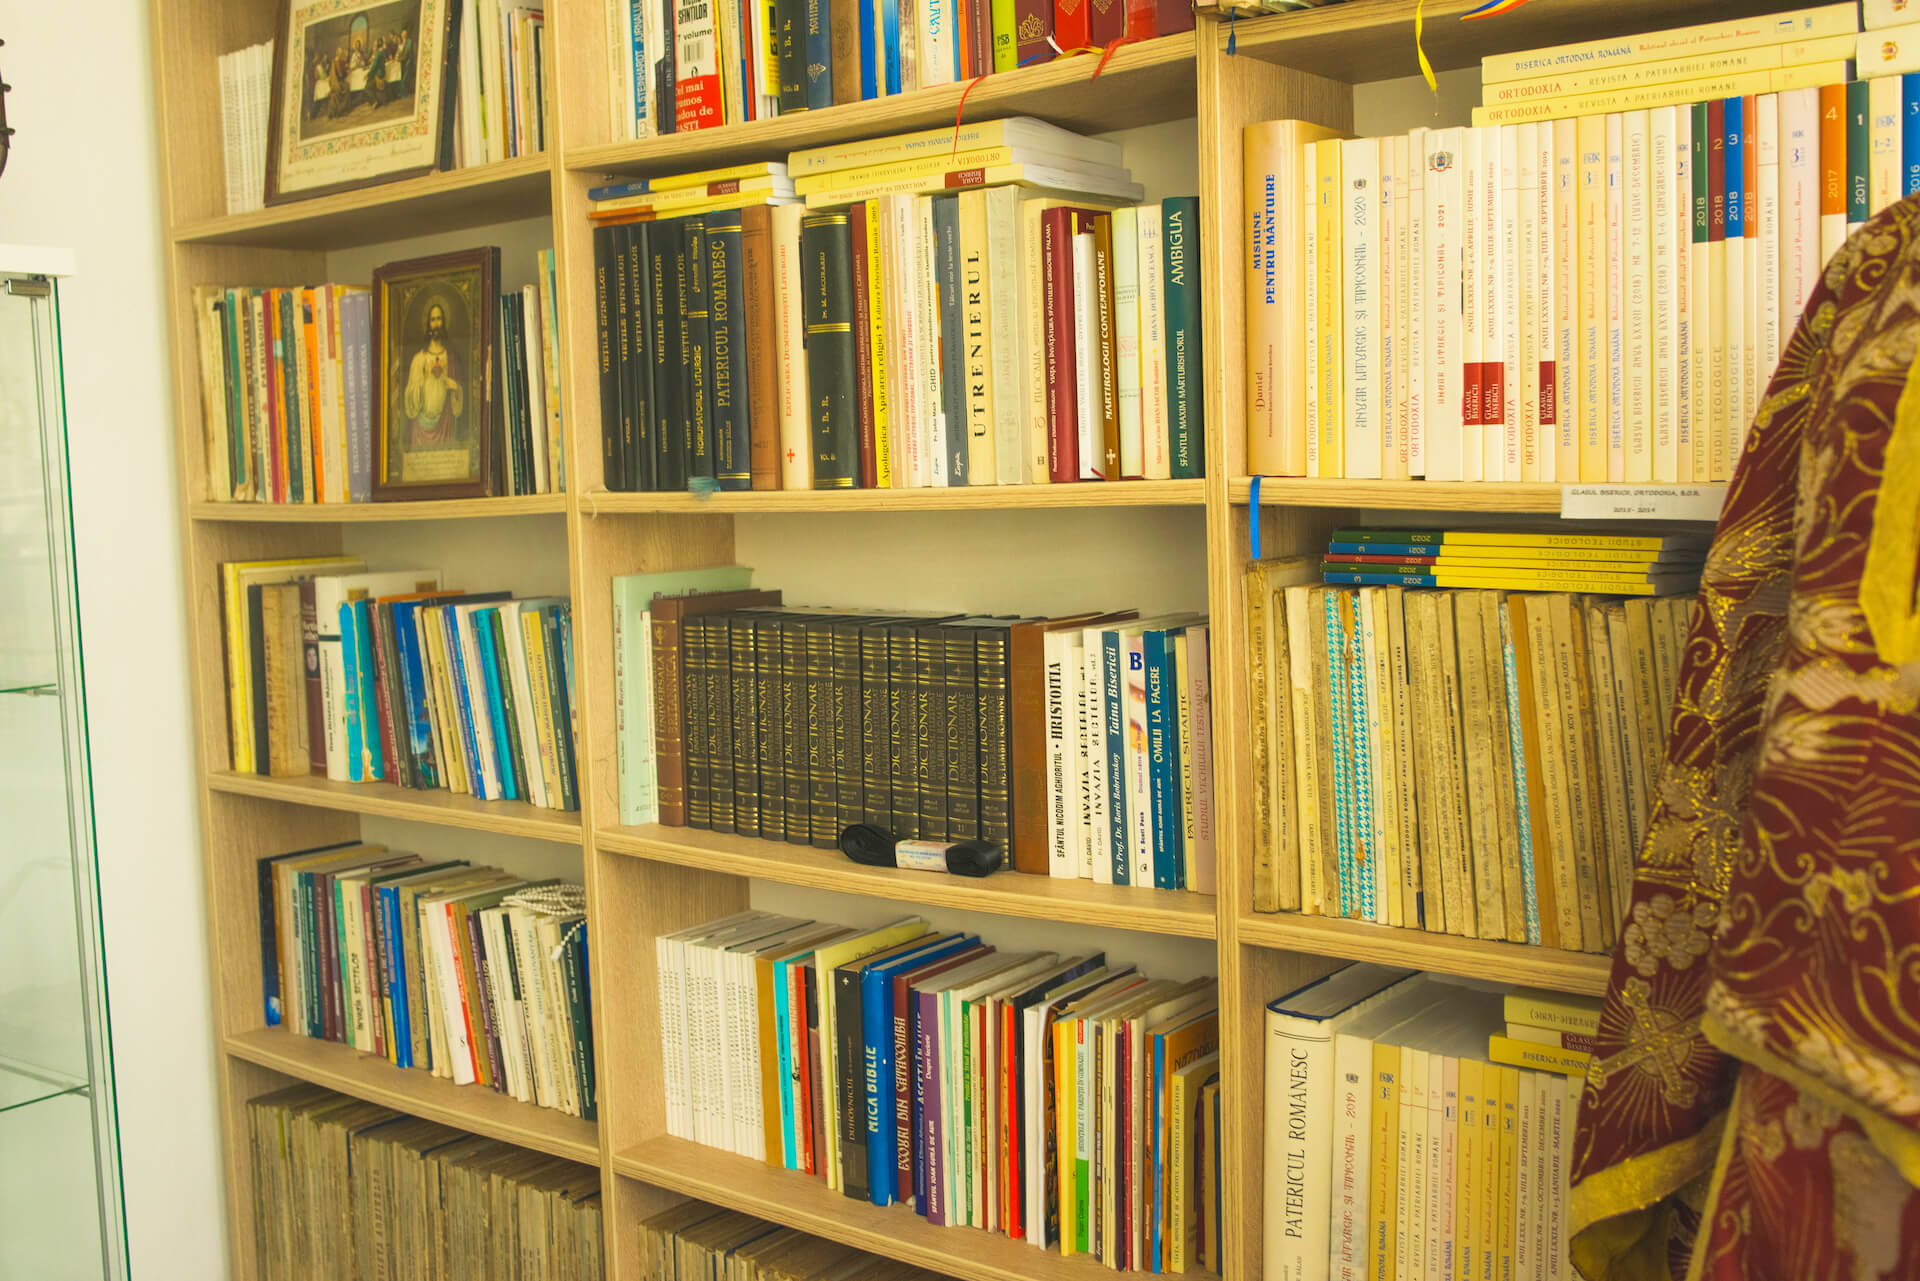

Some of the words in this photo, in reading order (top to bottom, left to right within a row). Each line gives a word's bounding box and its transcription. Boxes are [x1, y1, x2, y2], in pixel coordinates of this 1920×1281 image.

[685, 81, 704, 91] mai
[1498, 81, 1562, 100] ORTODOXIA
[699, 106, 713, 116] de
[1488, 103, 1552, 121] ORTODOXIA
[1714, 138, 1723, 150] 2
[1729, 134, 1738, 145] 3
[1828, 169, 1838, 198] 2017
[1856, 175, 1865, 204] 2017
[1264, 174, 1275, 245] MÂNTUIRE
[1354, 197, 1366, 226] 2020
[1696, 197, 1706, 226] 2018
[1713, 195, 1723, 224] 2018
[1728, 192, 1739, 221] 2018
[1744, 192, 1753, 222] 2018
[1169, 211, 1184, 285] AMBIGUA
[1253, 211, 1261, 270] MISIUNE
[1266, 249, 1275, 304] PENTRU
[1096, 251, 1109, 338] CONTEMPORANE
[876, 333, 884, 365] religiei
[967, 250, 986, 437] UTRENIERUL
[716, 326, 730, 407] PATERICUL
[1102, 341, 1113, 420] MARTIROLOGII
[1178, 400, 1187, 430] MAXIM
[1471, 383, 1479, 419] BISERICII
[1484, 389, 1492, 420] GLASUL
[1491, 383, 1499, 419] BISERICII
[1411, 394, 1419, 457] ORTODOXIA
[882, 426, 891, 481] Apologetica
[1177, 432, 1188, 466] SFÂNTUL
[1105, 646, 1118, 698] Bisericii
[1150, 666, 1161, 704] FACERE
[1048, 662, 1063, 740] HRISTOITIA
[1152, 709, 1162, 723] LA
[1195, 679, 1205, 736] TESTAMENT
[1108, 701, 1120, 736] Taina
[1153, 728, 1163, 763] OMILII
[1054, 753, 1063, 793] AGHIORITUL
[1093, 760, 1102, 815] INVAZIA
[1111, 753, 1122, 800] Bobrinskoy
[1055, 795, 1064, 825] NICODIM
[1113, 801, 1122, 824] Boris
[1055, 827, 1065, 857] SFÂNTUL
[1114, 827, 1122, 839] Dr.
[1115, 841, 1125, 862] Prof.
[1116, 864, 1124, 875] Pr.
[865, 1045, 877, 1093] BIBLIE
[897, 1099, 908, 1120] DIN
[1288, 1048, 1308, 1140] ROMÂNESC
[867, 1097, 879, 1133] MICA
[1285, 1150, 1305, 1239] PATERICUL
